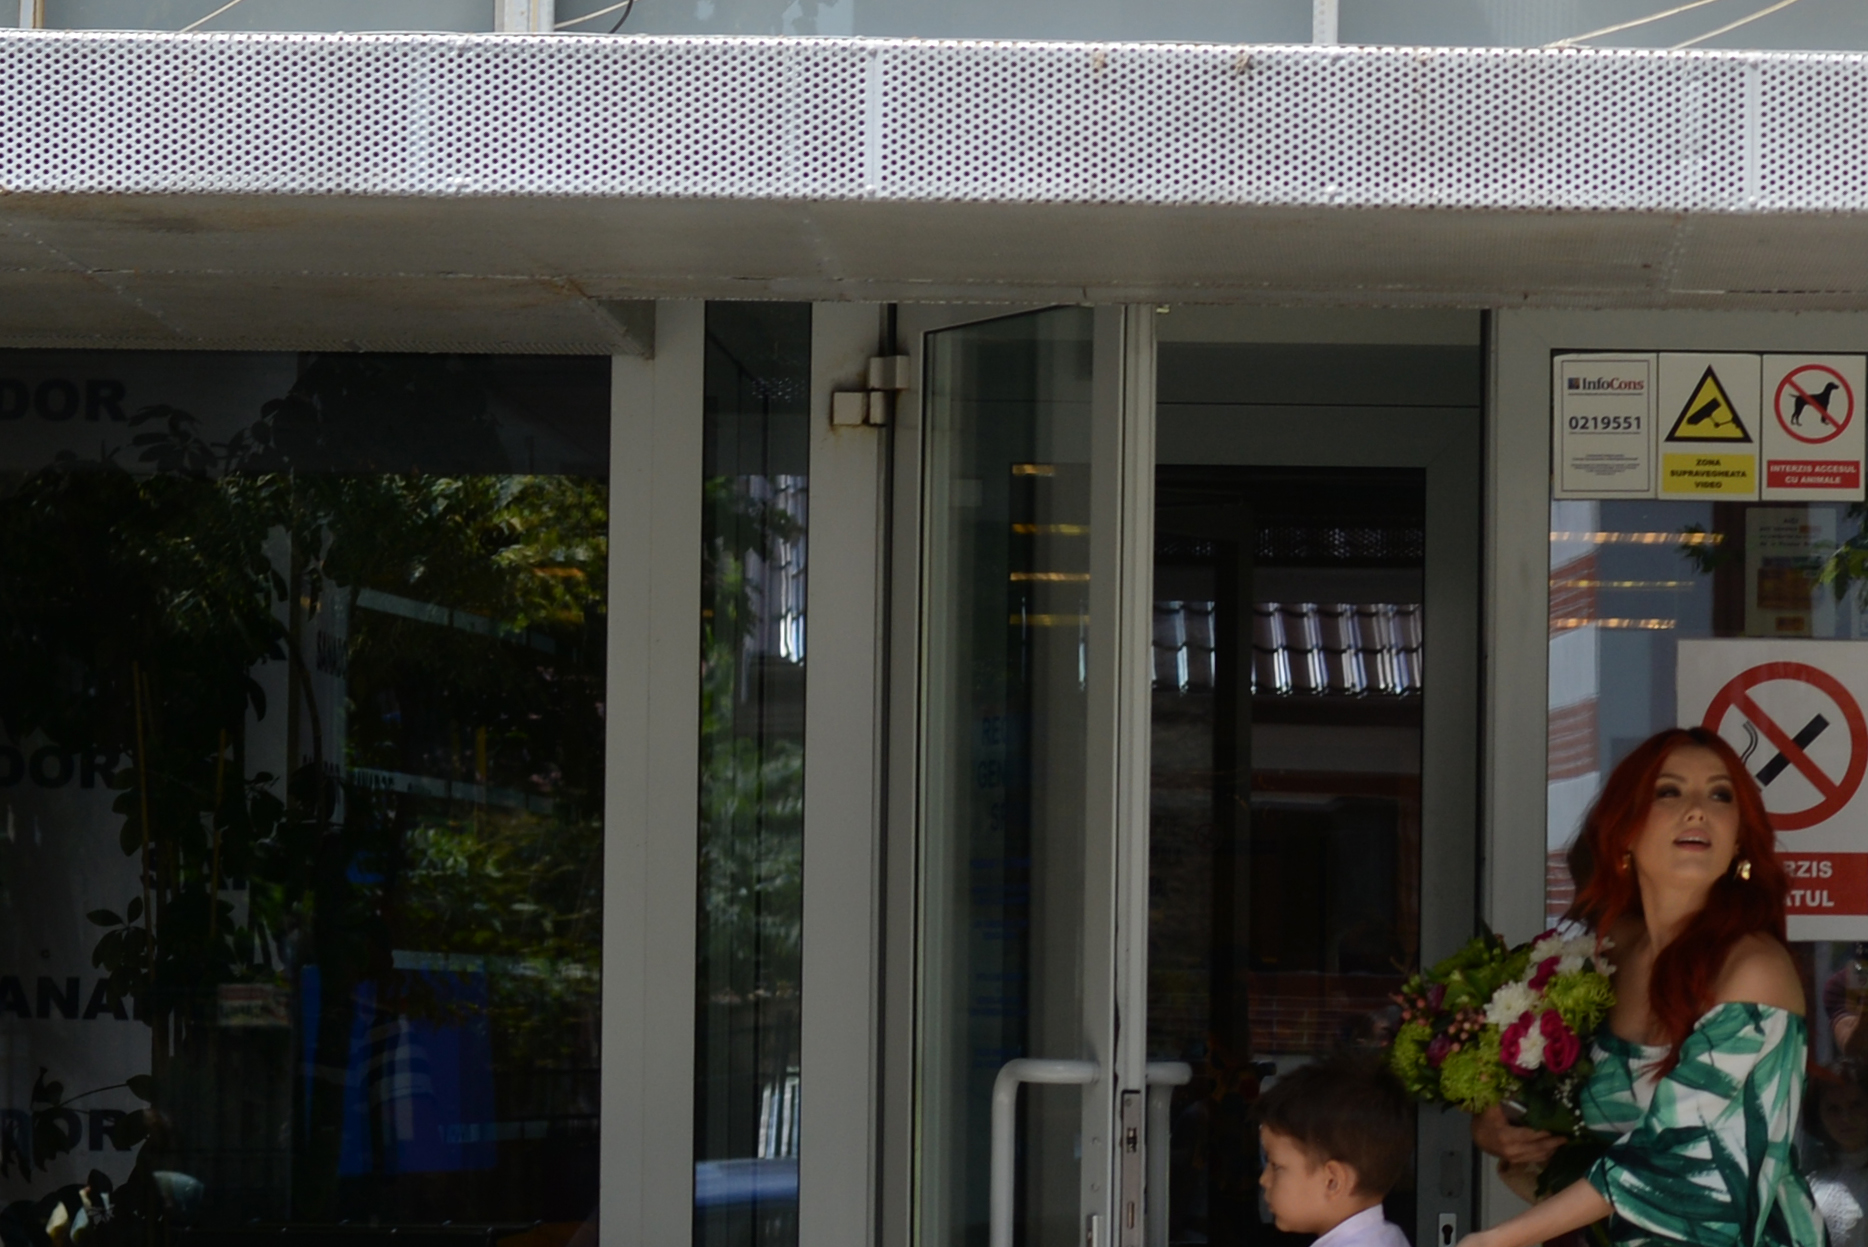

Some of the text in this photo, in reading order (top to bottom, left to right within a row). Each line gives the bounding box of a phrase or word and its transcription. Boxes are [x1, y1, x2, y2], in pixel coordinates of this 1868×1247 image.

[1582, 377, 1645, 391] InfoCons
[1568, 415, 1642, 430] 0219551
[1695, 458, 1721, 467] ZONA
[1770, 464, 1857, 473] INTERZIS ACCESUL
[1670, 469, 1747, 478] SUPRAVEGHEATA
[1784, 475, 1842, 484] CU ANIMALE
[1694, 481, 1723, 489] VIDEO
